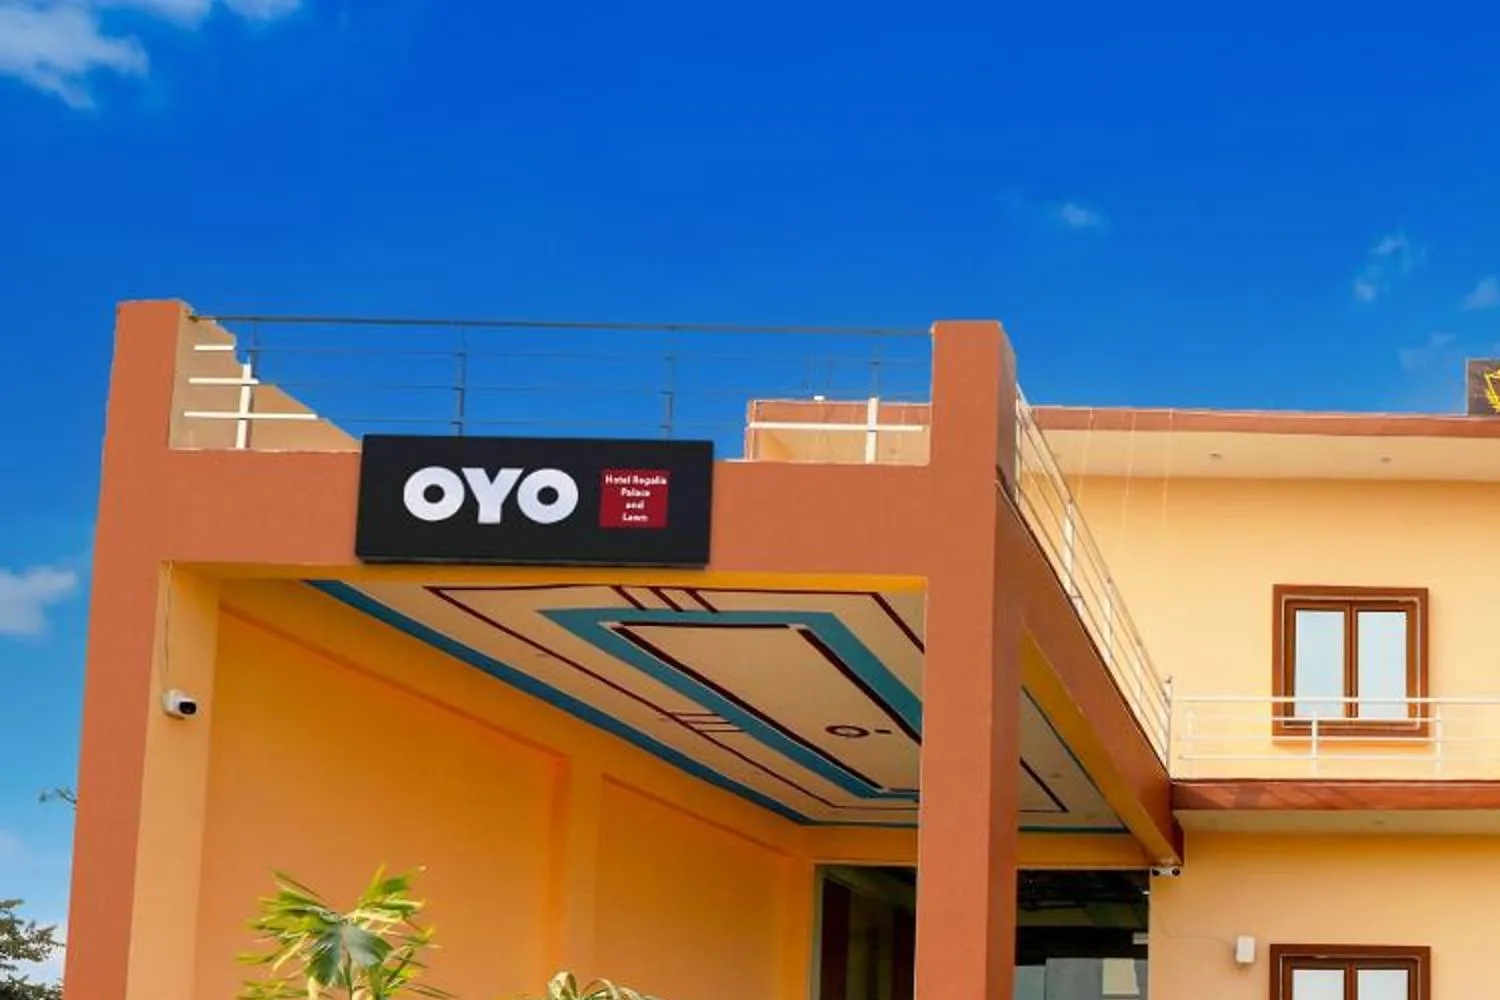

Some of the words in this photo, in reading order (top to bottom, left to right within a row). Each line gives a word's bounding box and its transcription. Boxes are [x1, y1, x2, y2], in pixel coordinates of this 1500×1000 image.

[605, 474, 630, 484] Hotel
[632, 475, 667, 487] Regalia
[403, 466, 579, 524] OYO
[621, 487, 650, 497] Palace
[626, 500, 645, 509] and
[623, 512, 648, 521] Lawn
